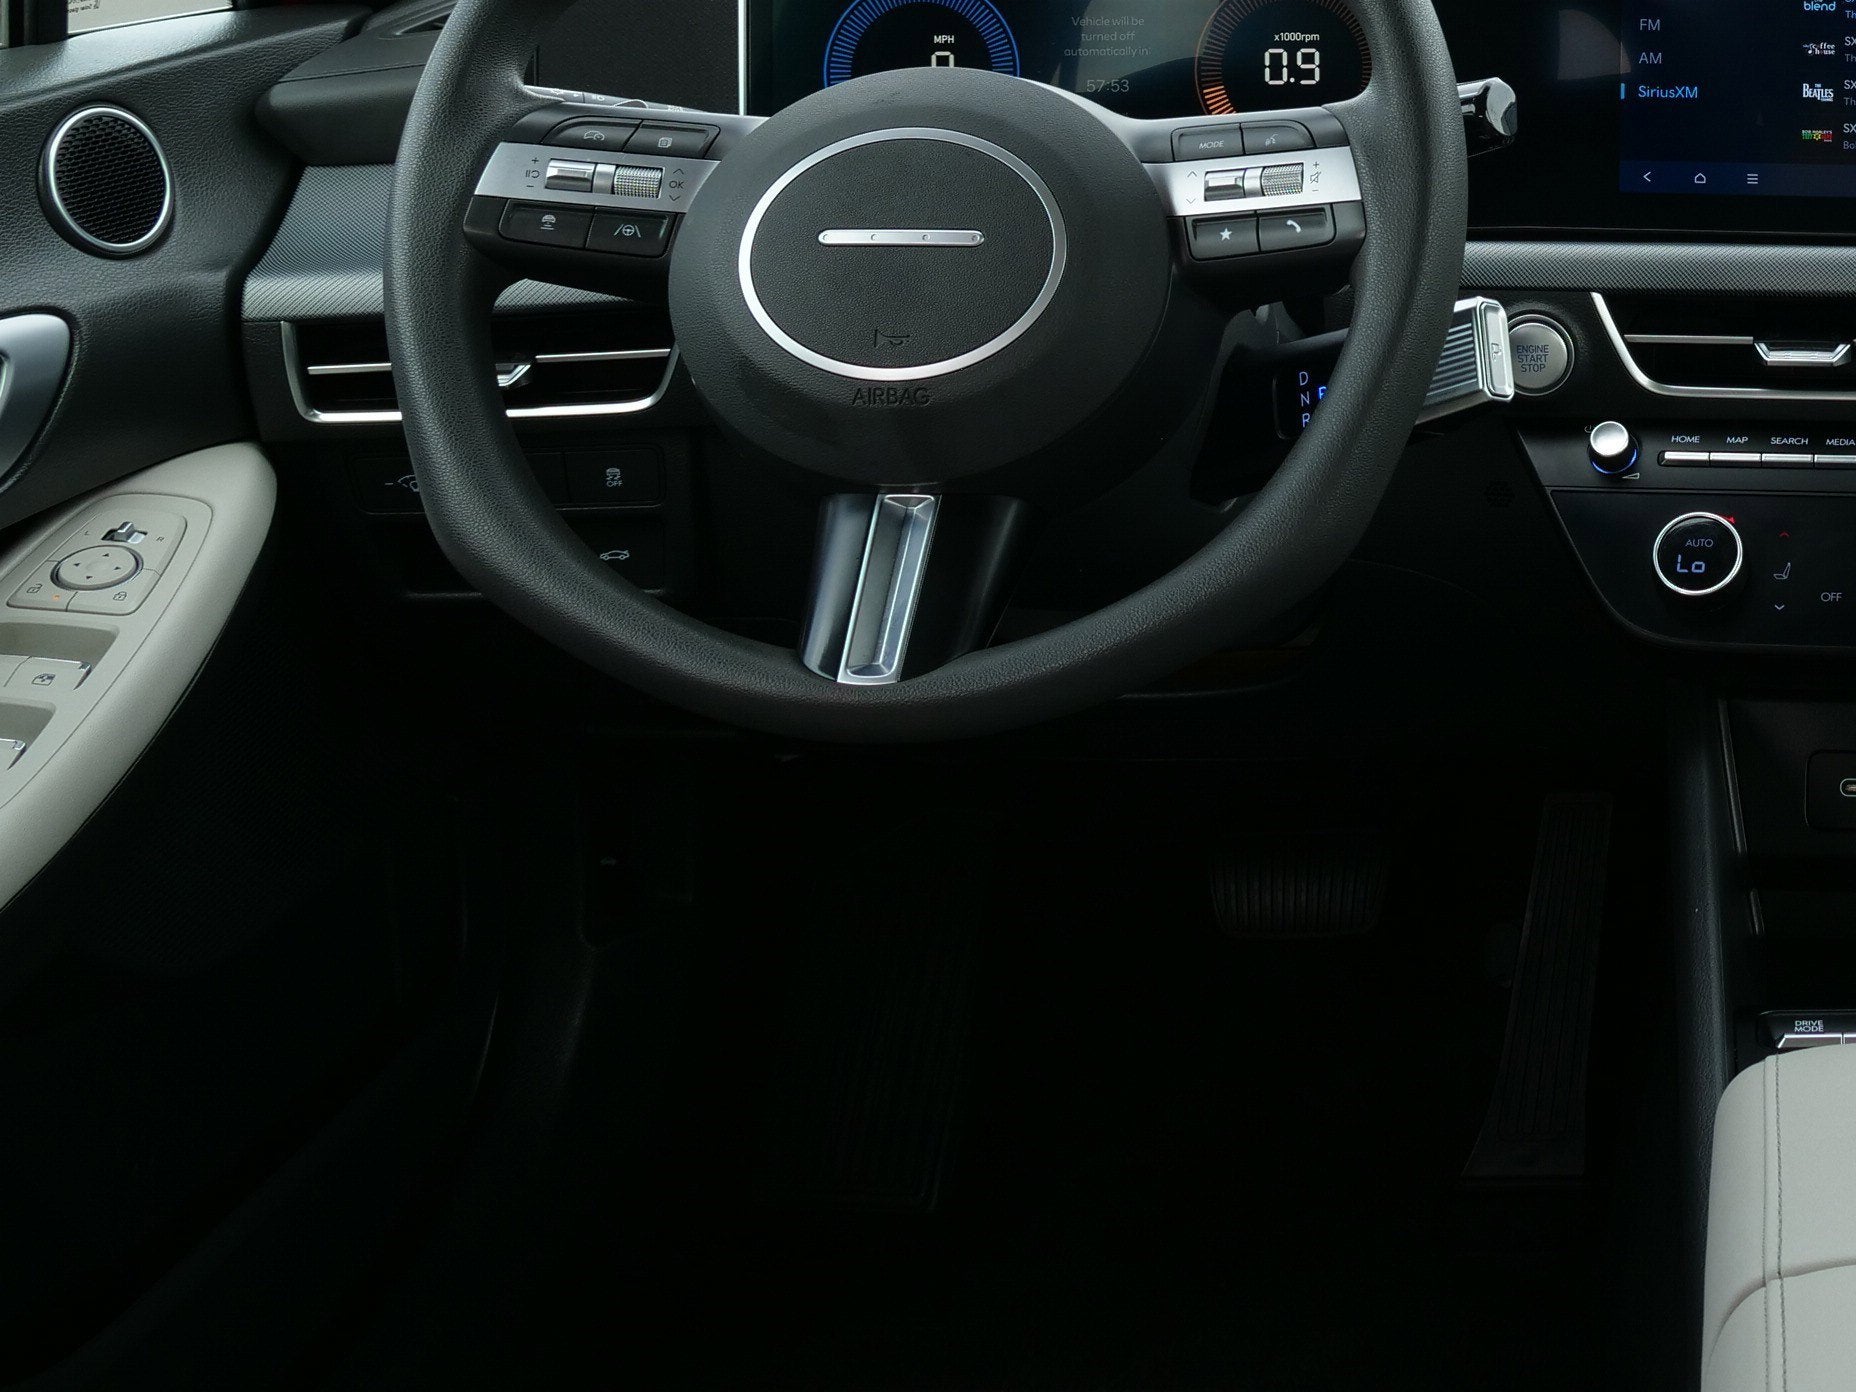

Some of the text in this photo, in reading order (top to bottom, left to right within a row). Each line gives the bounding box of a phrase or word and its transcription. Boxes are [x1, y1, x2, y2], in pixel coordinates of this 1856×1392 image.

[1803, 0, 1837, 11] blend
[1071, 16, 1144, 26] Vehicle will be
[1639, 18, 1661, 31] FM
[934, 35, 955, 43] MPH
[1081, 31, 1136, 41] turned off
[1274, 32, 1320, 42] x1000rpm
[1064, 46, 1137, 57] automatically
[1638, 52, 1662, 64] AM
[1264, 48, 1320, 85] 0.9
[1086, 79, 1129, 92] 57:53
[1638, 85, 1698, 98] SiriusXM
[1199, 140, 1224, 149] MODE
[669, 180, 684, 189] OK
[1516, 344, 1549, 354] ENGINE
[1518, 354, 1549, 363] START
[1521, 363, 1546, 373] STOP
[1299, 371, 1309, 386] D
[852, 387, 931, 406] AIRBAG
[1300, 391, 1310, 407] N
[1671, 435, 1700, 443] HOME
[1726, 436, 1749, 444] MAP
[1770, 437, 1809, 445] SEARCH
[1825, 438, 1856, 446] MEDIA
[1685, 538, 1714, 547] AUTO
[1820, 592, 1842, 602] OFF
